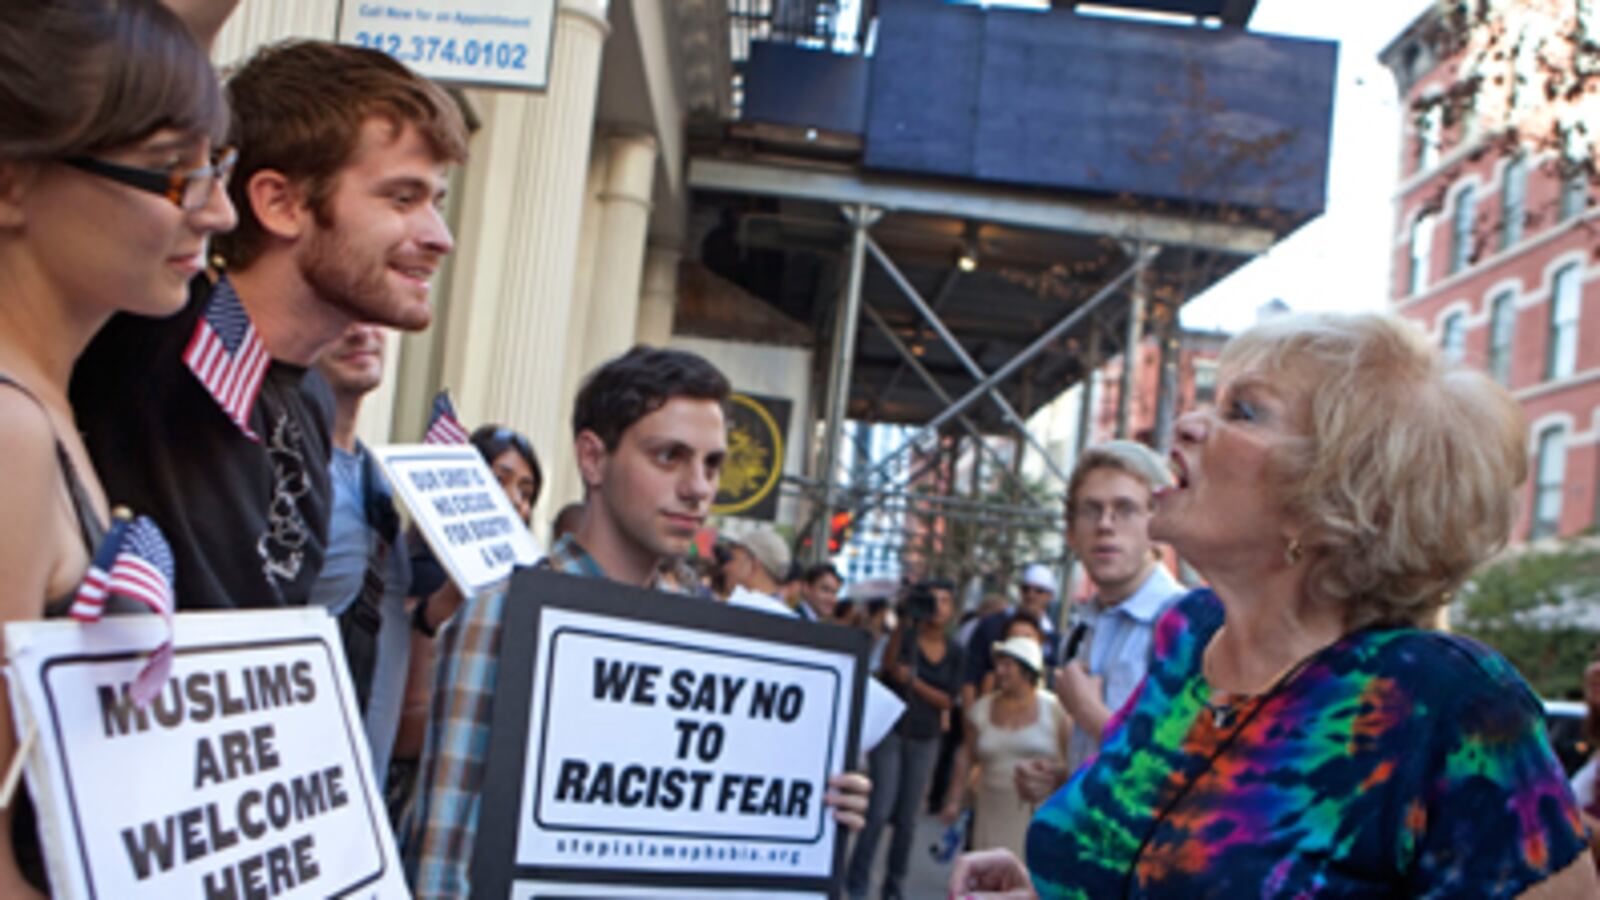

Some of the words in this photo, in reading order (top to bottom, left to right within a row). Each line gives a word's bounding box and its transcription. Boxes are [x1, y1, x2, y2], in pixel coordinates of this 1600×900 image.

[386, 6, 412, 20] Now
[98, 660, 318, 738] MUSLIMS
[592, 657, 662, 707] WE
[667, 669, 747, 715] SAY
[748, 680, 805, 723] NO
[193, 723, 280, 790] ARE
[674, 718, 726, 764] TO
[554, 758, 714, 812] RACIST
[716, 774, 814, 819] FEAR
[121, 765, 348, 881] WELCOME
[556, 838, 802, 867] stopislamophobia.org
[202, 834, 320, 900] HERE
